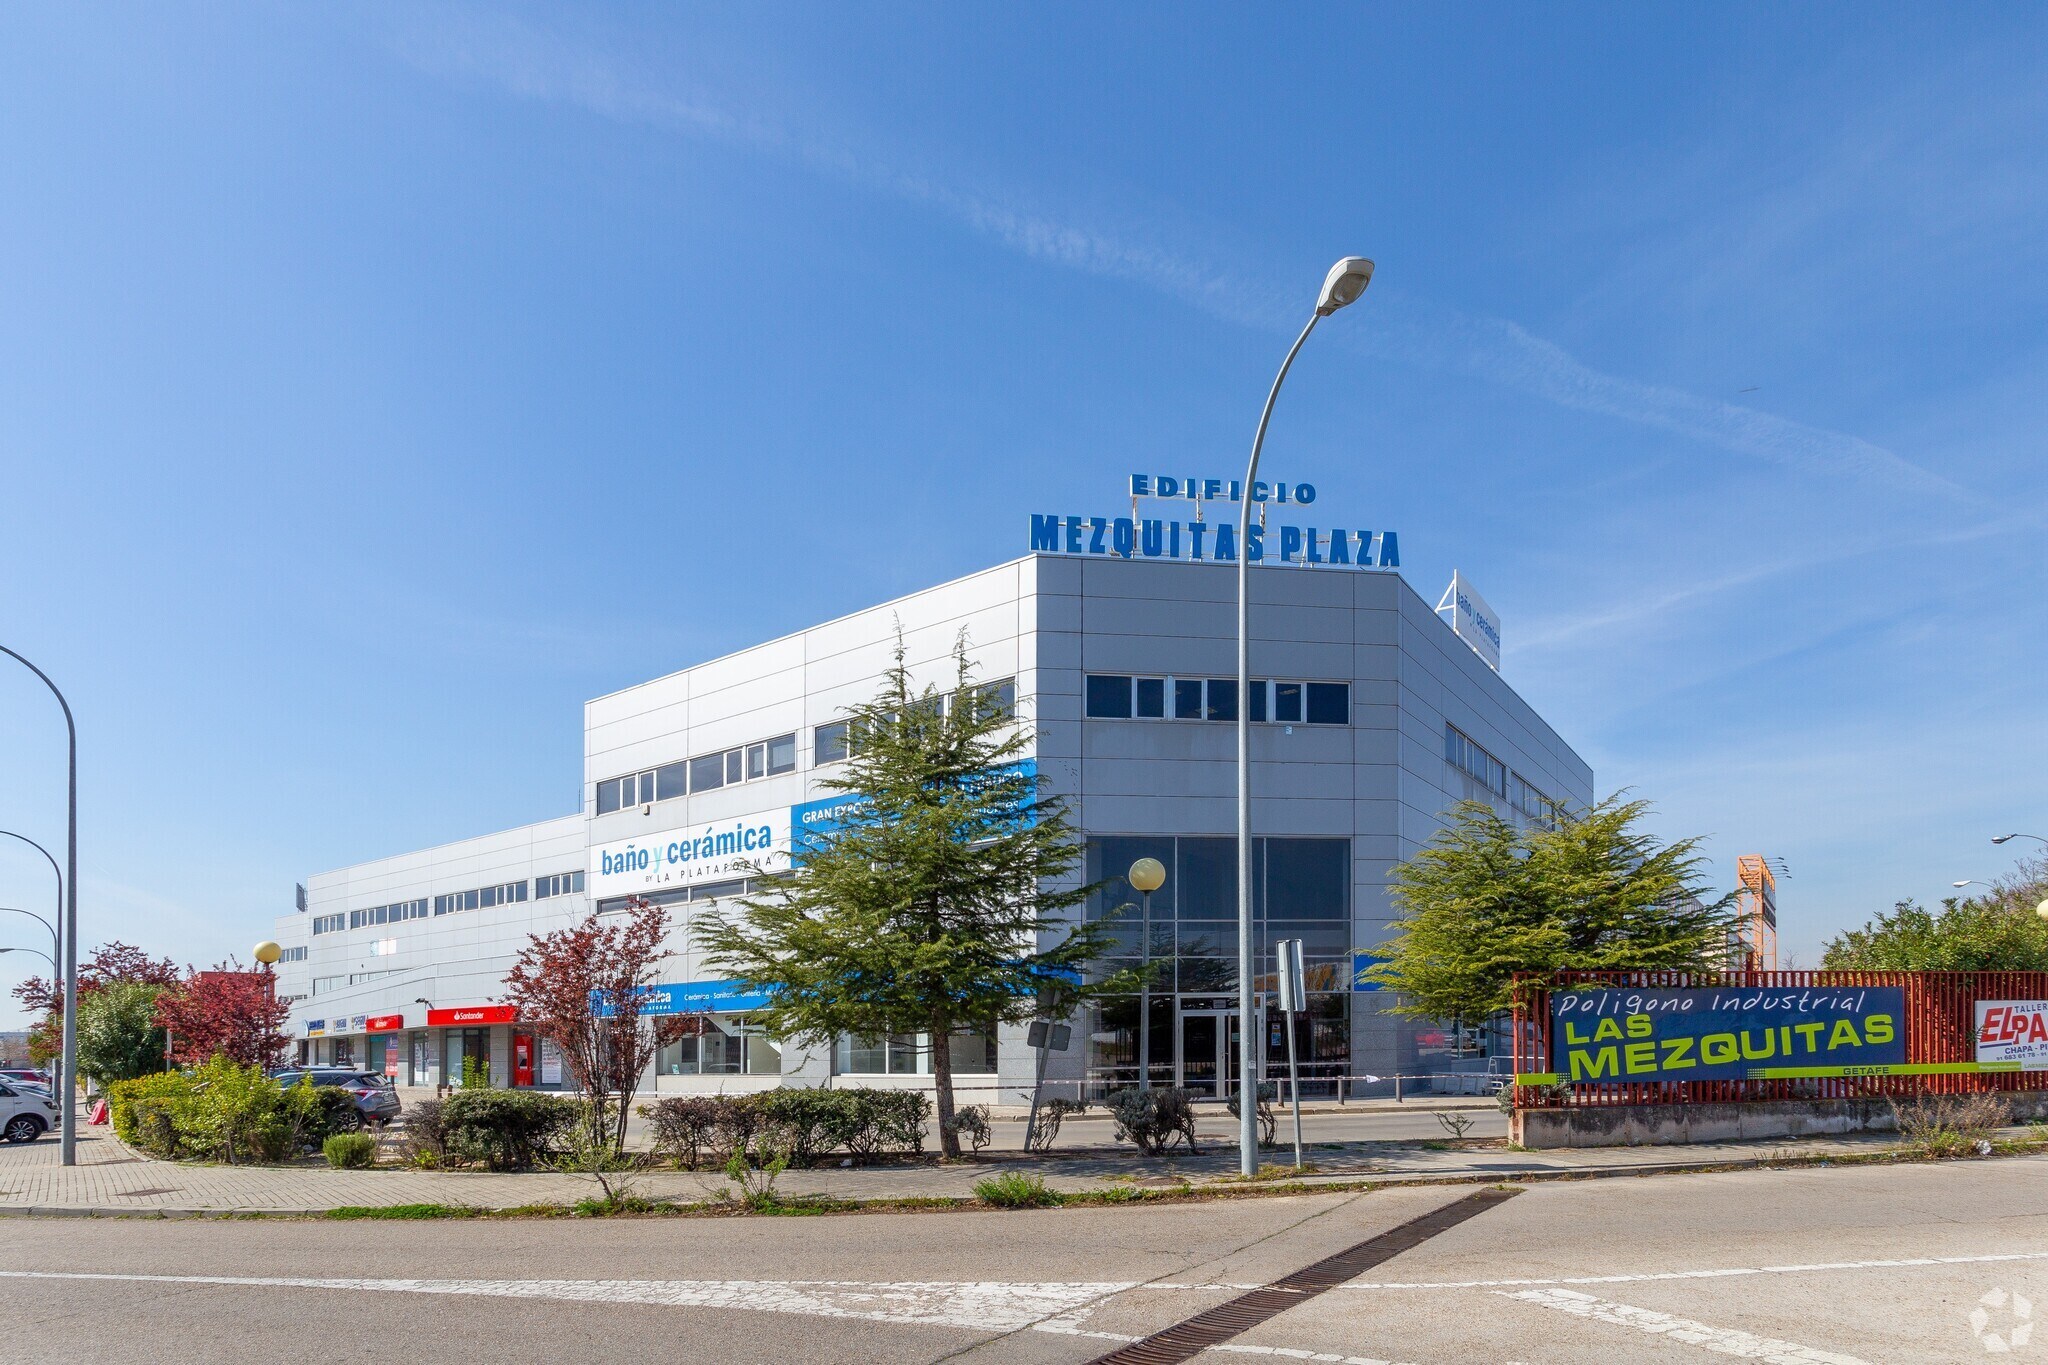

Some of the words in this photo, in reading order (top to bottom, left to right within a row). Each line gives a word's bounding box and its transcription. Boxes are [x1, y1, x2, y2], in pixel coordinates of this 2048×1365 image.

[1130, 474, 1316, 504] EDIFICIO
[1029, 514, 1264, 561] MEZQUITAS
[1279, 525, 1400, 567] PLAZA
[802, 807, 832, 824] GRAN
[602, 844, 649, 876] baño
[653, 845, 663, 873] y
[667, 822, 771, 865] cerámica
[657, 873, 669, 883] LA
[680, 856, 772, 879] PLATAFORMA
[1712, 990, 1867, 1013] Industrial
[459, 1011, 484, 1020] Santander
[1565, 1014, 1653, 1045] LAS
[1568, 1013, 1896, 1081] MEZQUITAS
[2005, 1045, 2032, 1054] CHAPA
[1842, 1066, 1889, 1076] GETAFE
